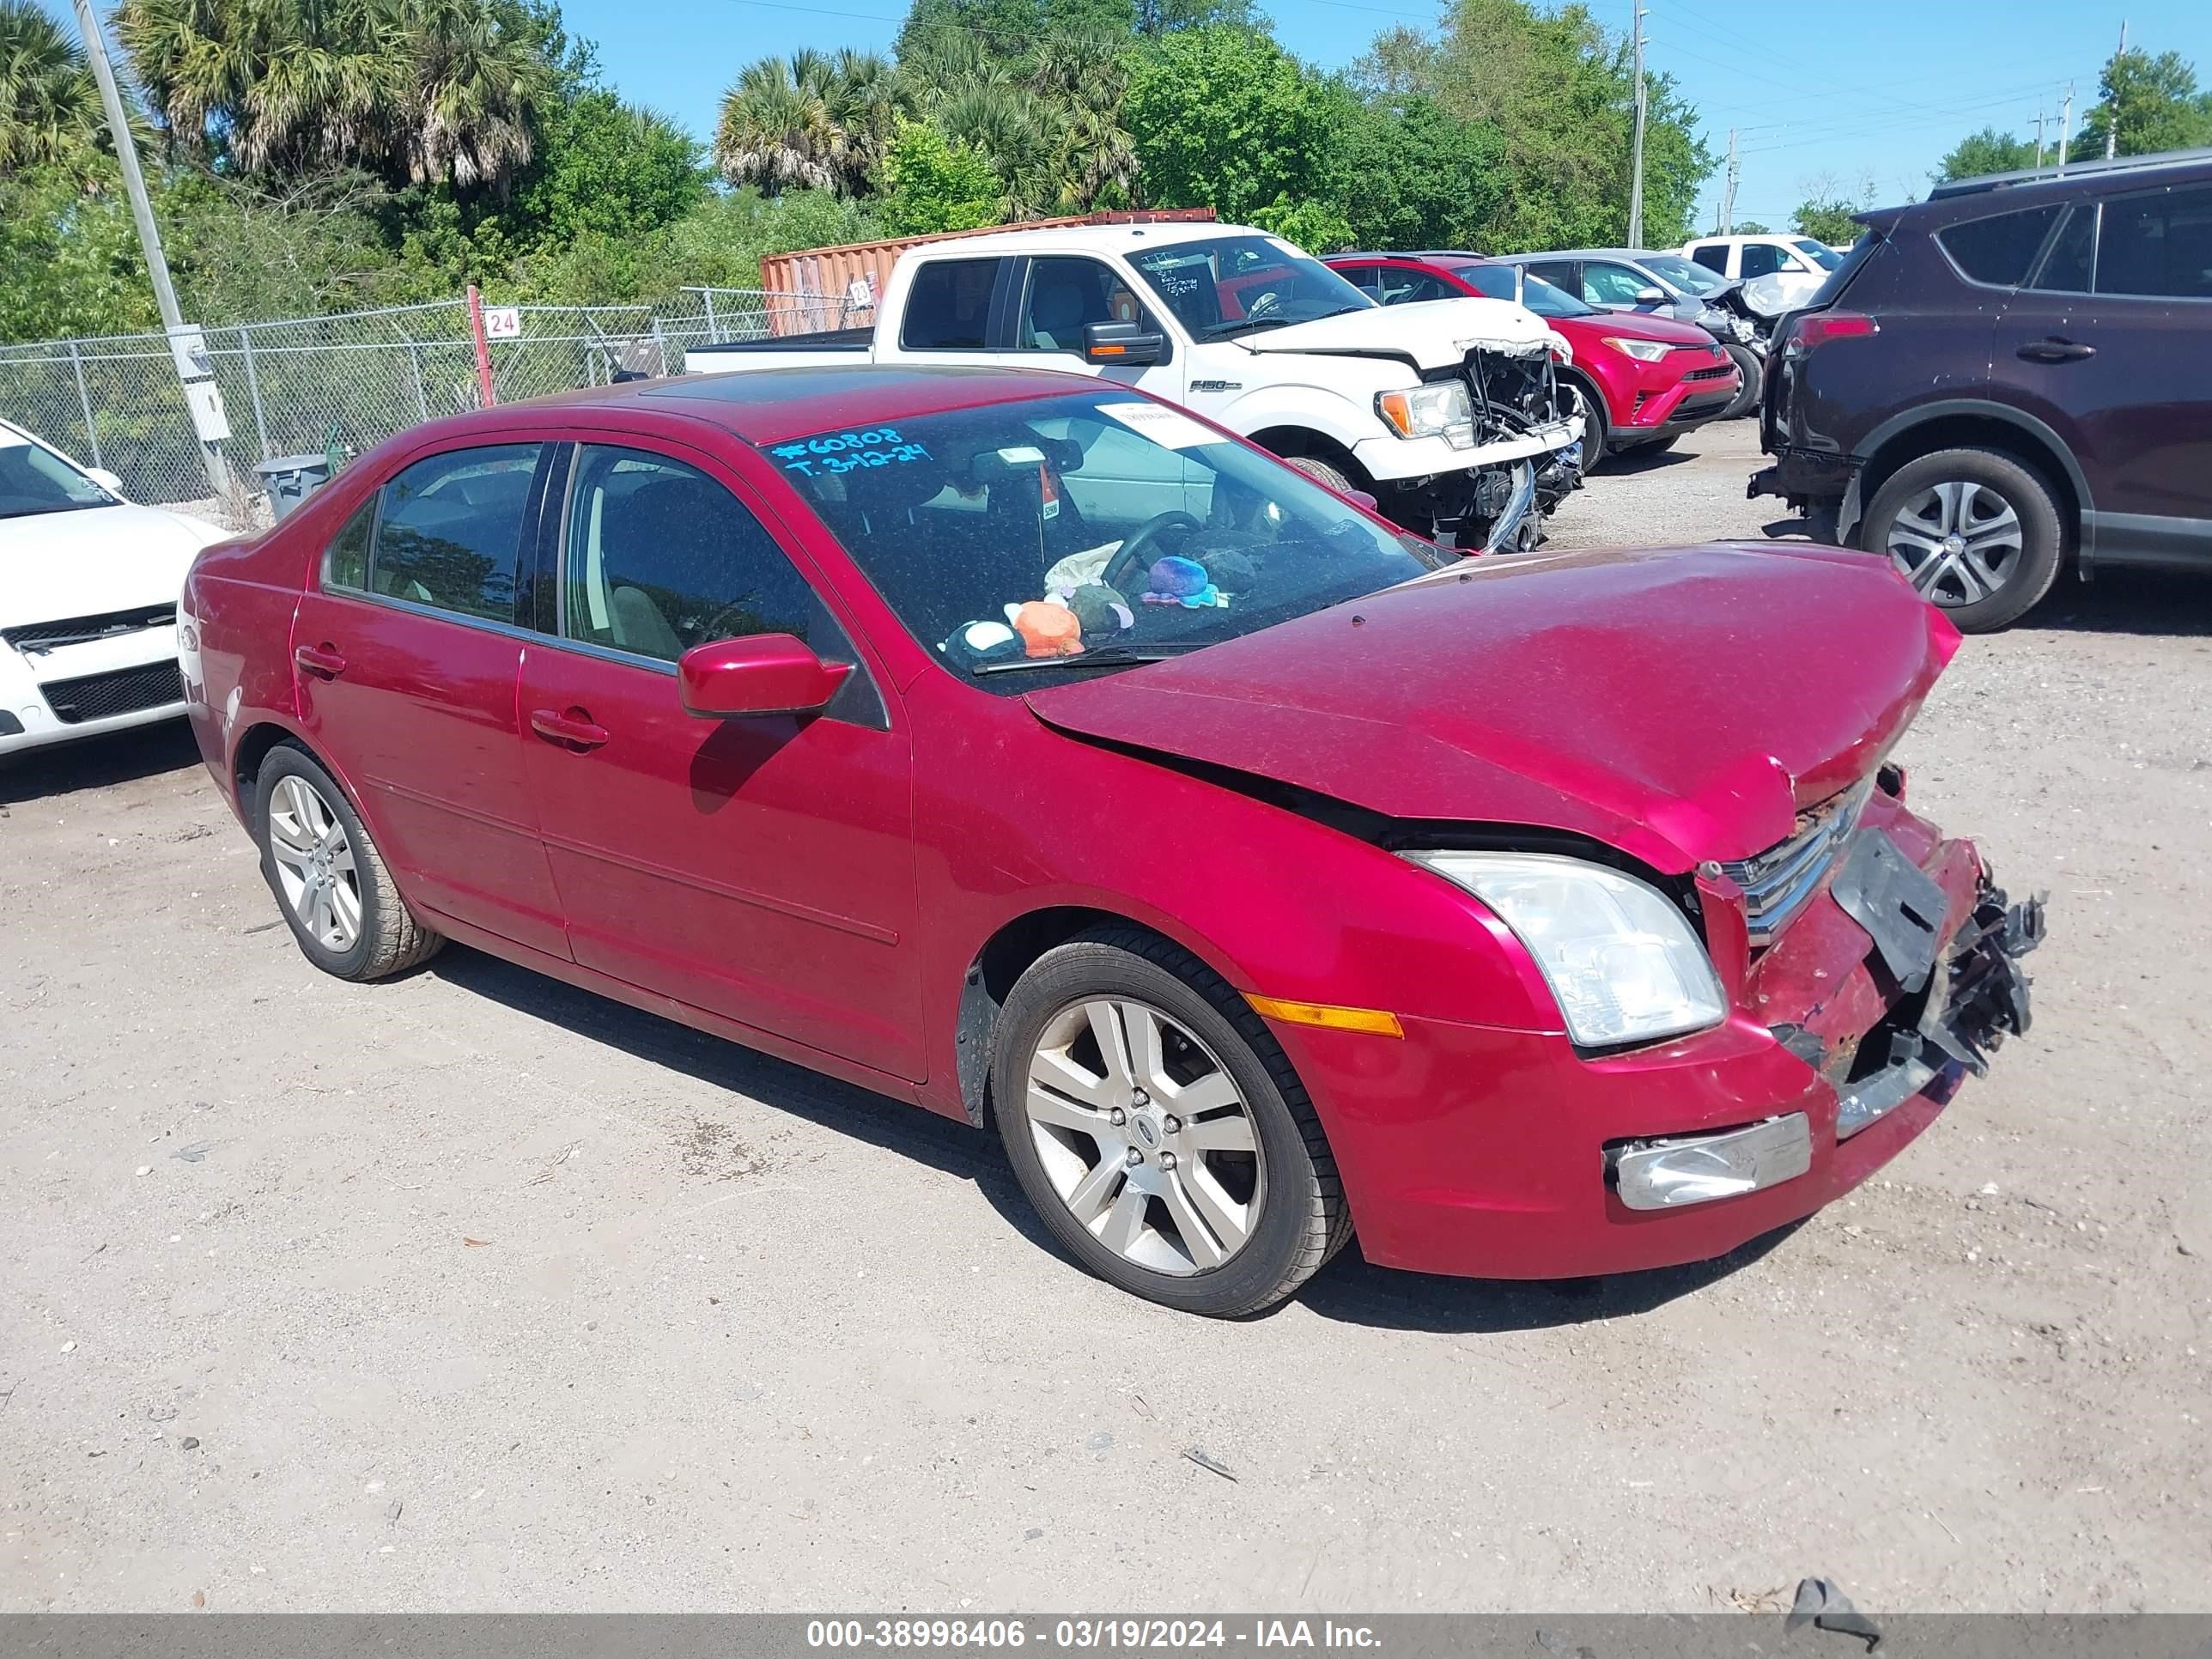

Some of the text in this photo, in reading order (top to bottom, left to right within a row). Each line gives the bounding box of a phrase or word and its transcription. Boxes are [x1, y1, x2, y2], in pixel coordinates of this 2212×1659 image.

[854, 285, 868, 301] 23
[490, 313, 514, 332] 24
[772, 429, 902, 459] #60808
